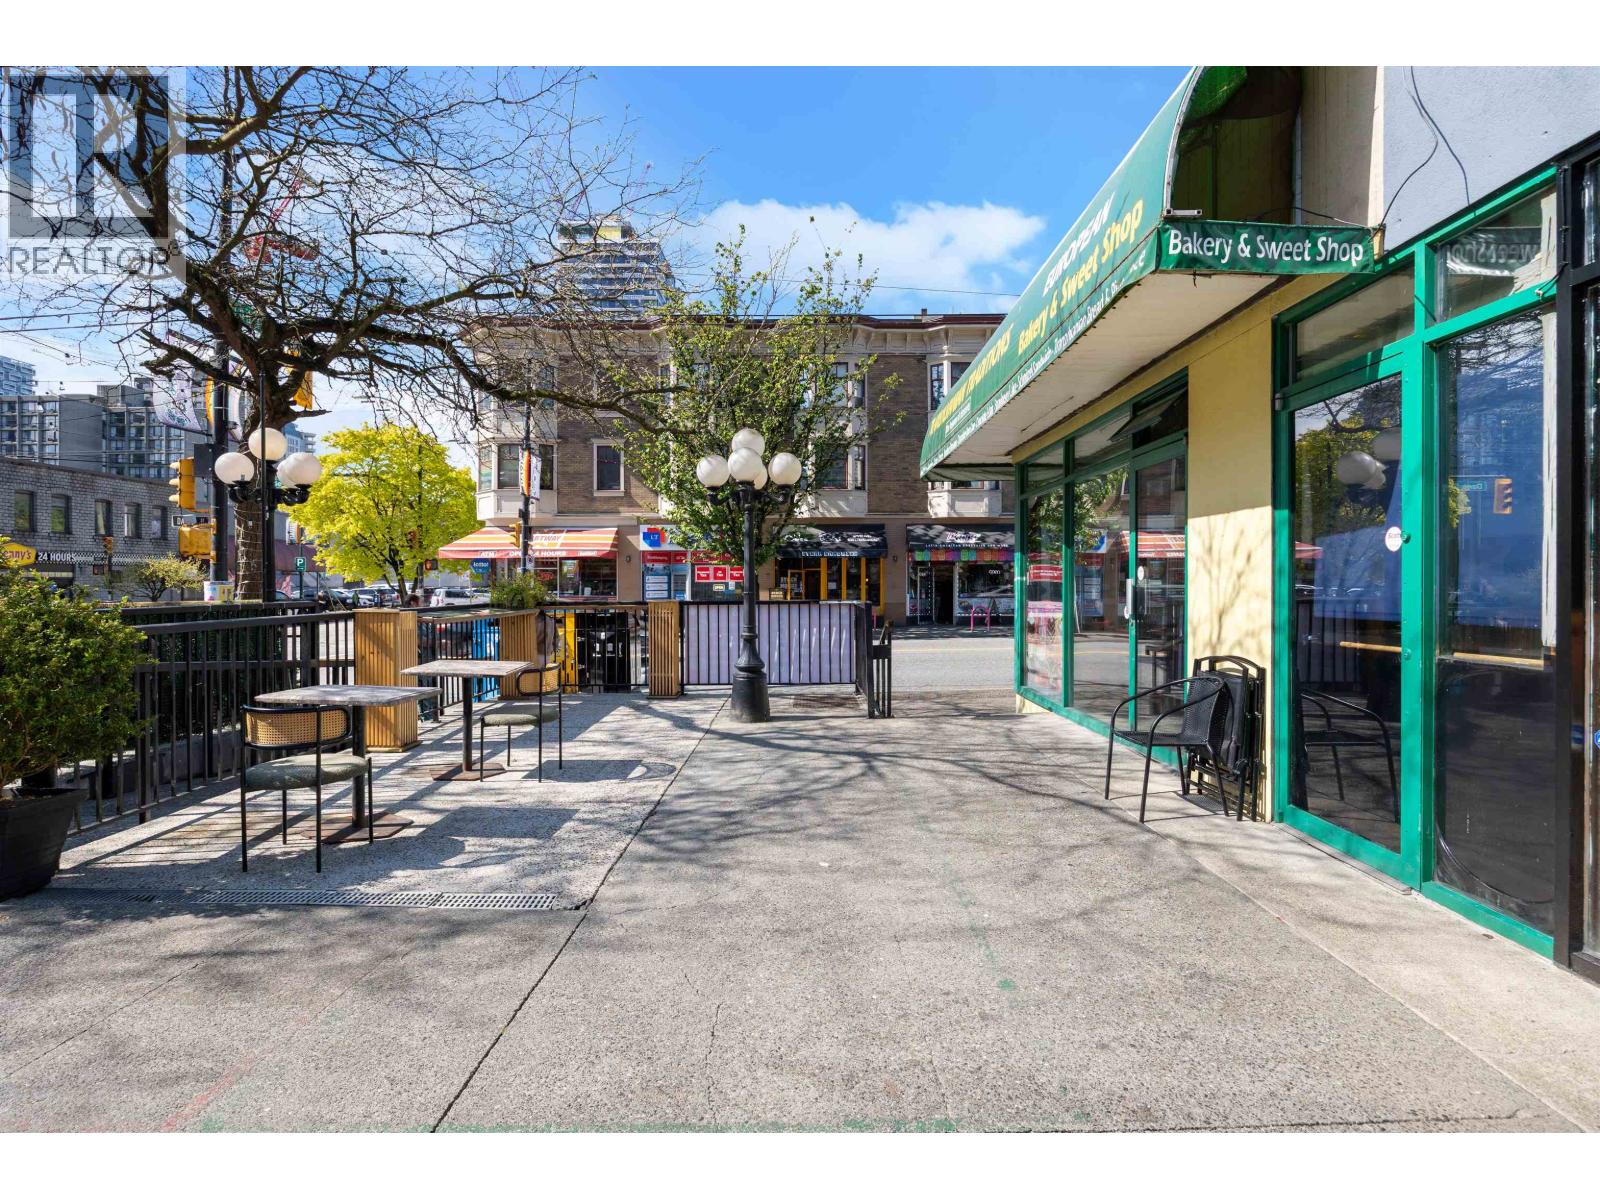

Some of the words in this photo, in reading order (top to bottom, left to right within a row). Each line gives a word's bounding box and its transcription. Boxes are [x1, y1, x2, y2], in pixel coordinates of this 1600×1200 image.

[1168, 229, 1233, 264] Bakery
[1238, 233, 1251, 258] &
[1256, 234, 1312, 261] Sweet
[1316, 236, 1364, 267] Shop
[1017, 304, 1049, 356] Bakery
[1049, 289, 1059, 319] &
[1060, 244, 1100, 308] Sweet
[1100, 199, 1144, 265] Shop
[38, 551, 48, 561] 24
[50, 551, 76, 562] HOURS
[297, 558, 304, 567] P
